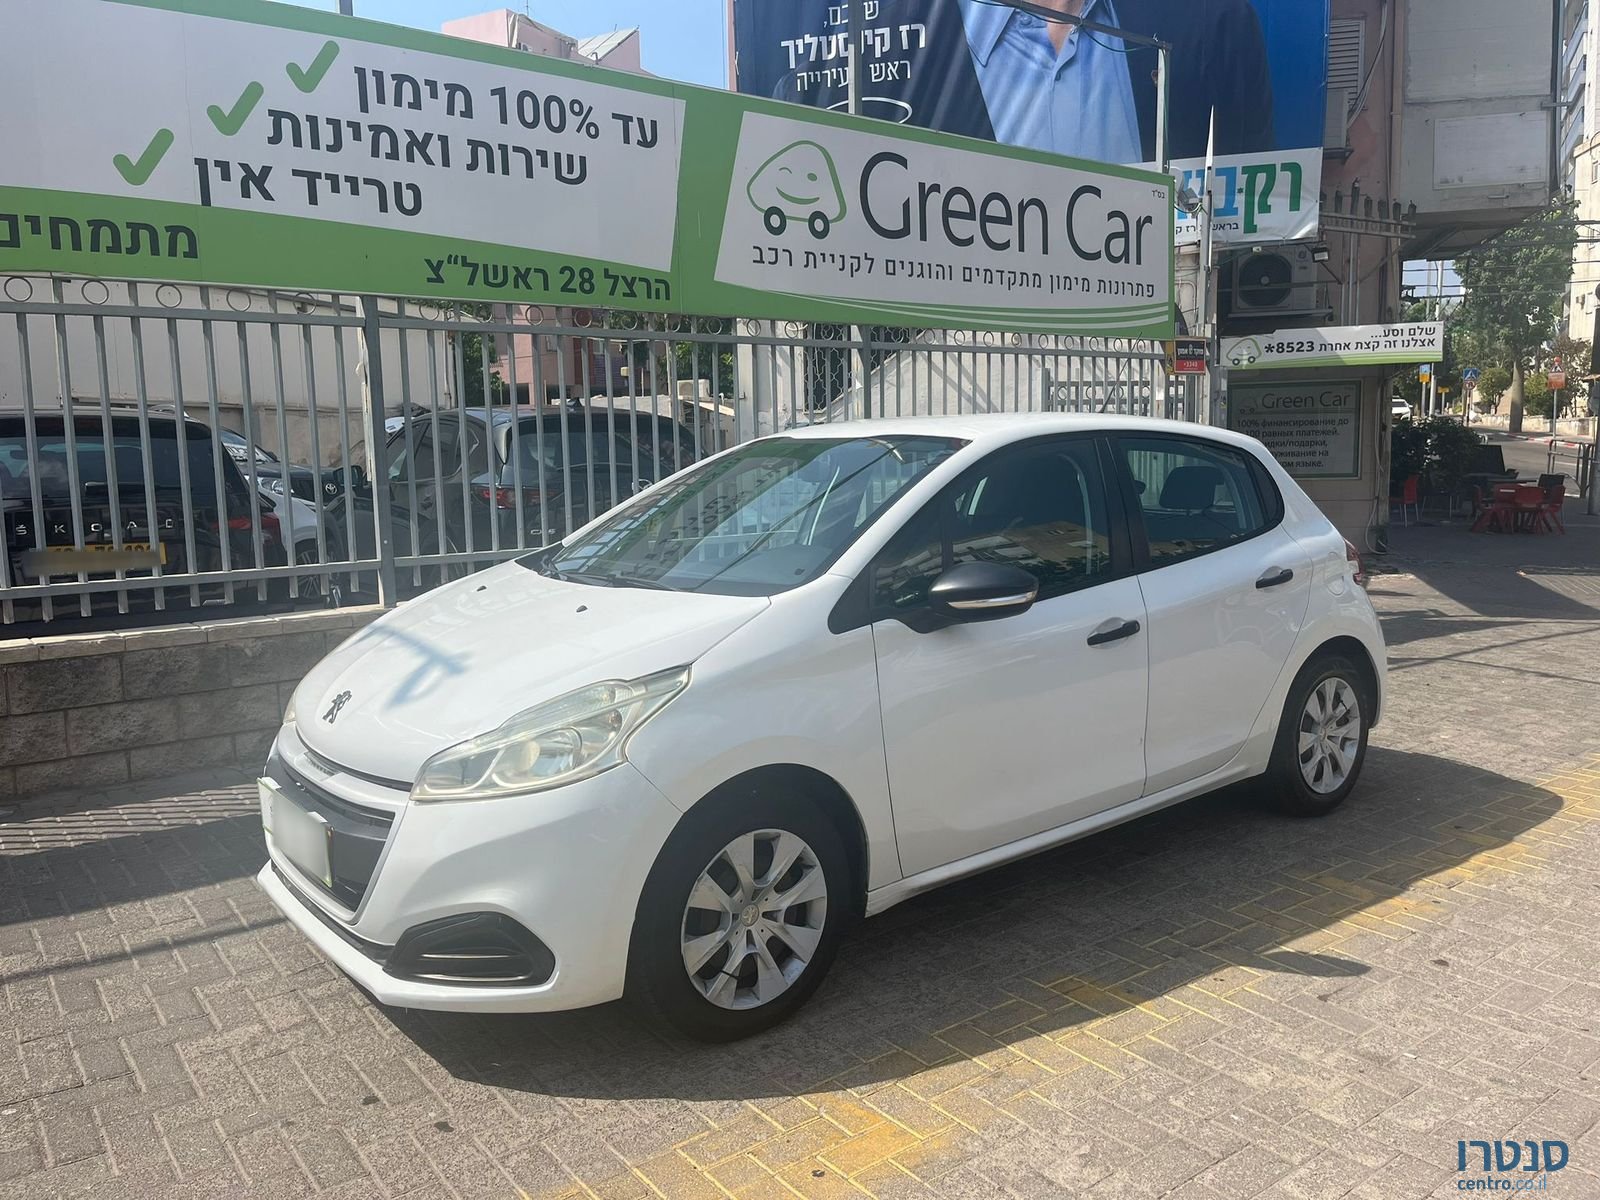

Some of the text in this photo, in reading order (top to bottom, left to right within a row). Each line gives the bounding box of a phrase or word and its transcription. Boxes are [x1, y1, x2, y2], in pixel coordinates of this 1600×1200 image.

[899, 23, 926, 50] רז
[796, 60, 911, 91] ראש עירייה
[353, 66, 659, 149] עד 100% מימון
[267, 107, 588, 186] שירות ואמינות
[193, 156, 423, 217] טרייד אין
[859, 151, 1050, 257] Green
[1065, 184, 1153, 266] Car
[559, 265, 596, 295] 28
[752, 245, 1155, 298] פתרונות מימון מתקדמים והוגנים לקניית רכב
[604, 267, 671, 301] הרצל
[1408, 326, 1436, 337] שלם
[1318, 342, 1351, 352] אחרת
[1355, 340, 1380, 351] קצת
[1384, 339, 1398, 348] זה
[1401, 337, 1435, 348] אצלנו
[1261, 391, 1351, 409] Green Car
[1237, 419, 1260, 428] 100%
[1260, 418, 1336, 429] финансирование
[1261, 429, 1295, 439] равных
[1295, 426, 1341, 437] платежей.
[1264, 440, 1328, 449] идки/подарки,
[1295, 460, 1324, 468] языке.
